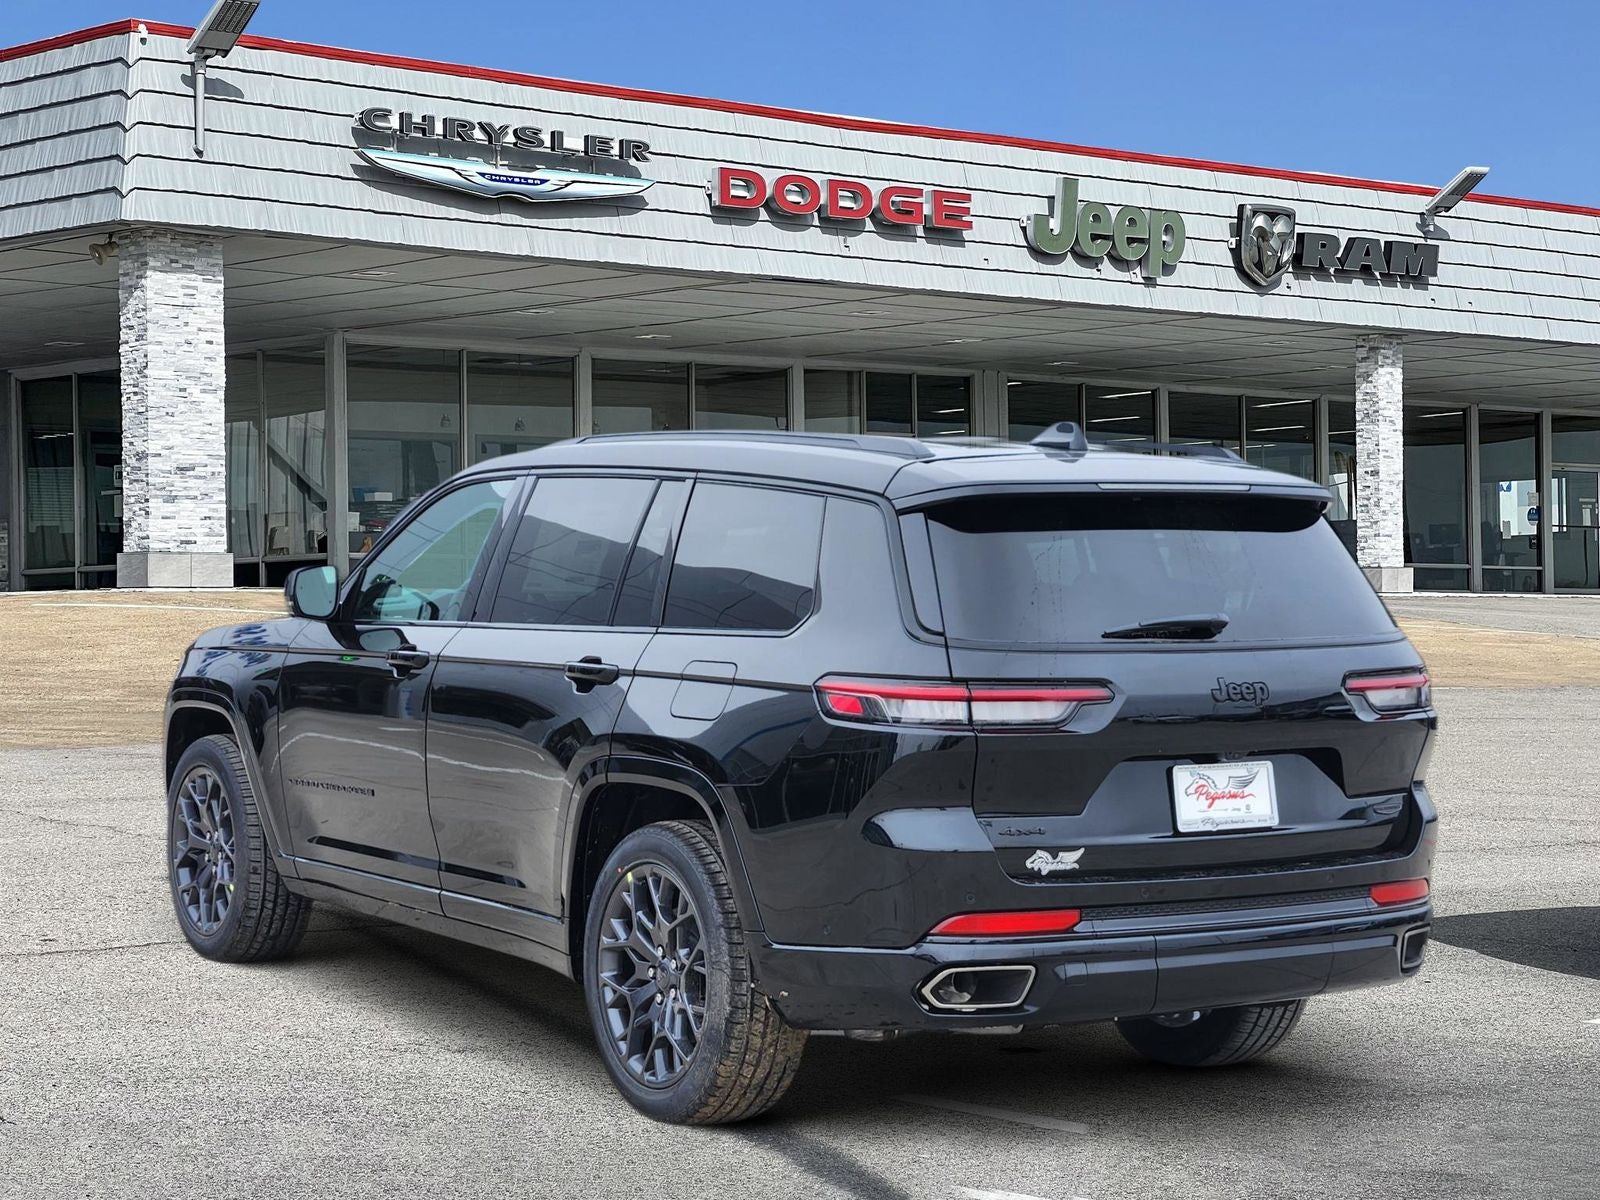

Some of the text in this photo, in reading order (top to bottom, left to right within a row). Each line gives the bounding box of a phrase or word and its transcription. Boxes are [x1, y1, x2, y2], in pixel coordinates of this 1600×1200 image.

[358, 106, 651, 162] CHRYSLER
[484, 174, 541, 185] CHRYSLER
[711, 166, 973, 232] DODGE
[1022, 177, 1186, 278] Jeep
[1296, 232, 1440, 278] RAM
[1211, 677, 1270, 706] Jeep
[1194, 783, 1257, 809] Pegasus
